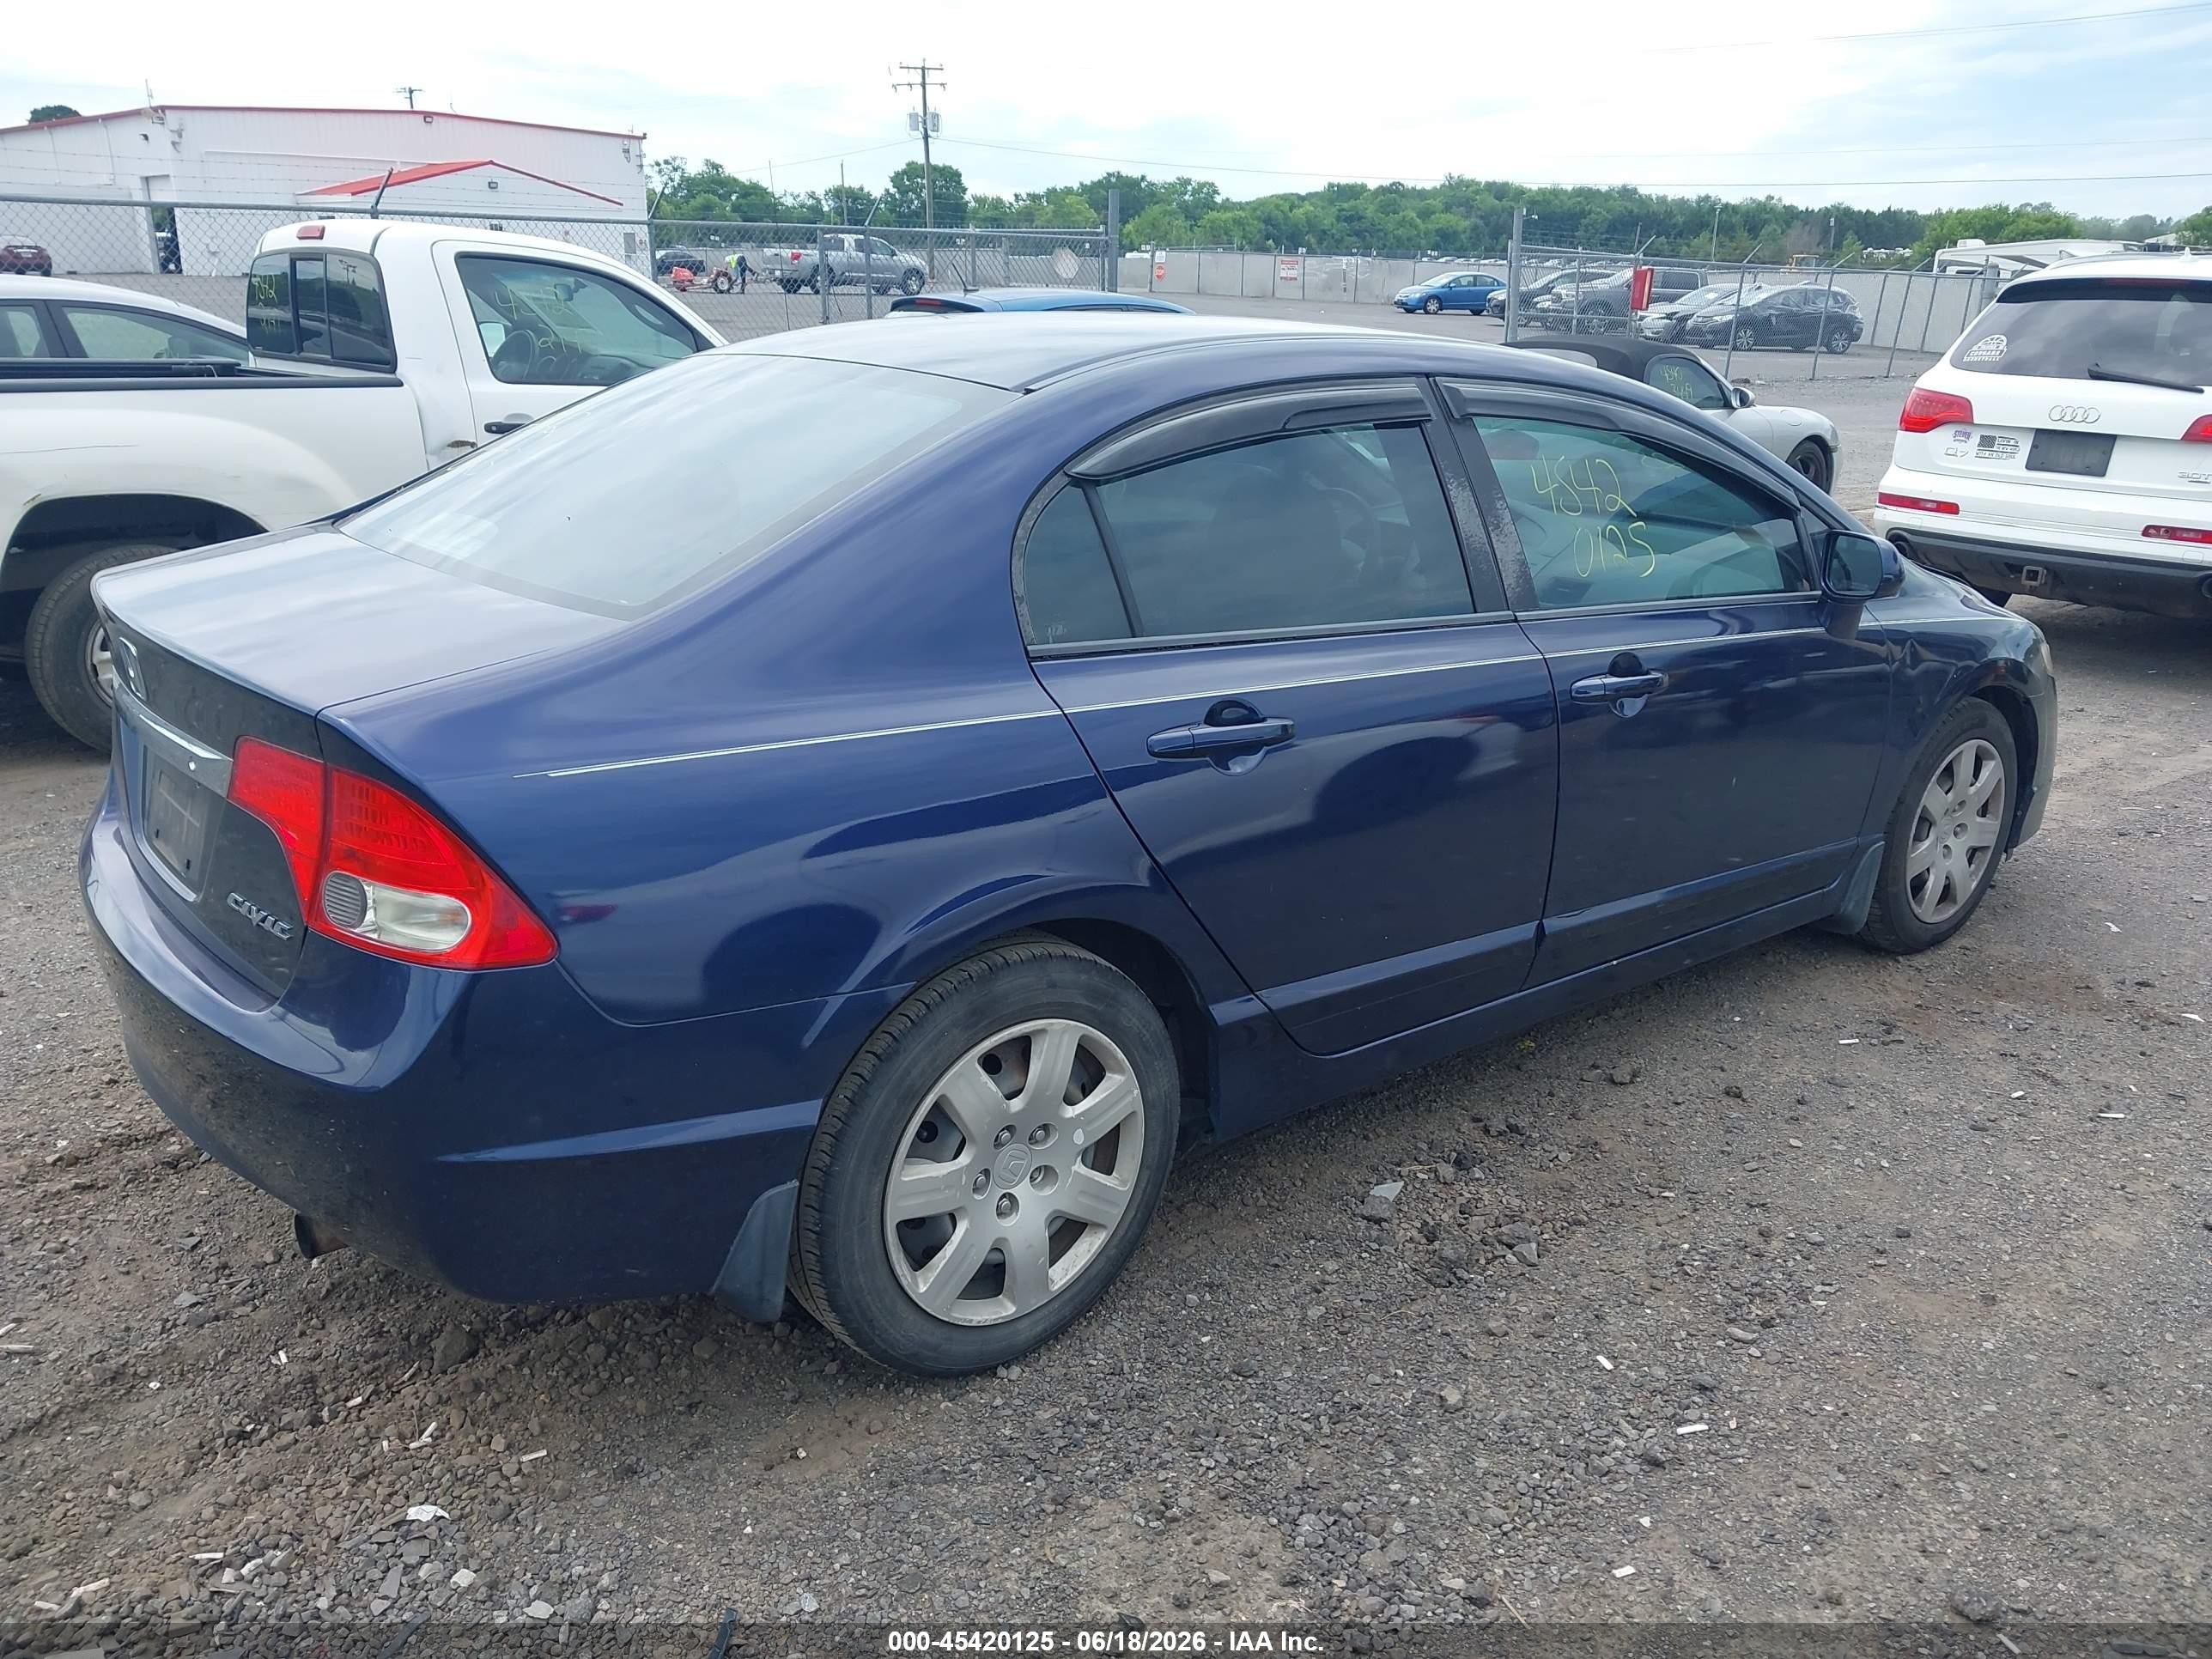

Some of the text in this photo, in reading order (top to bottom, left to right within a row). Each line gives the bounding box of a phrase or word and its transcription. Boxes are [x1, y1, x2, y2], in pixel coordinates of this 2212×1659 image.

[1531, 454, 1638, 518] 4542
[1573, 521, 1656, 578] 0125
[227, 892, 295, 941] CIVIC
